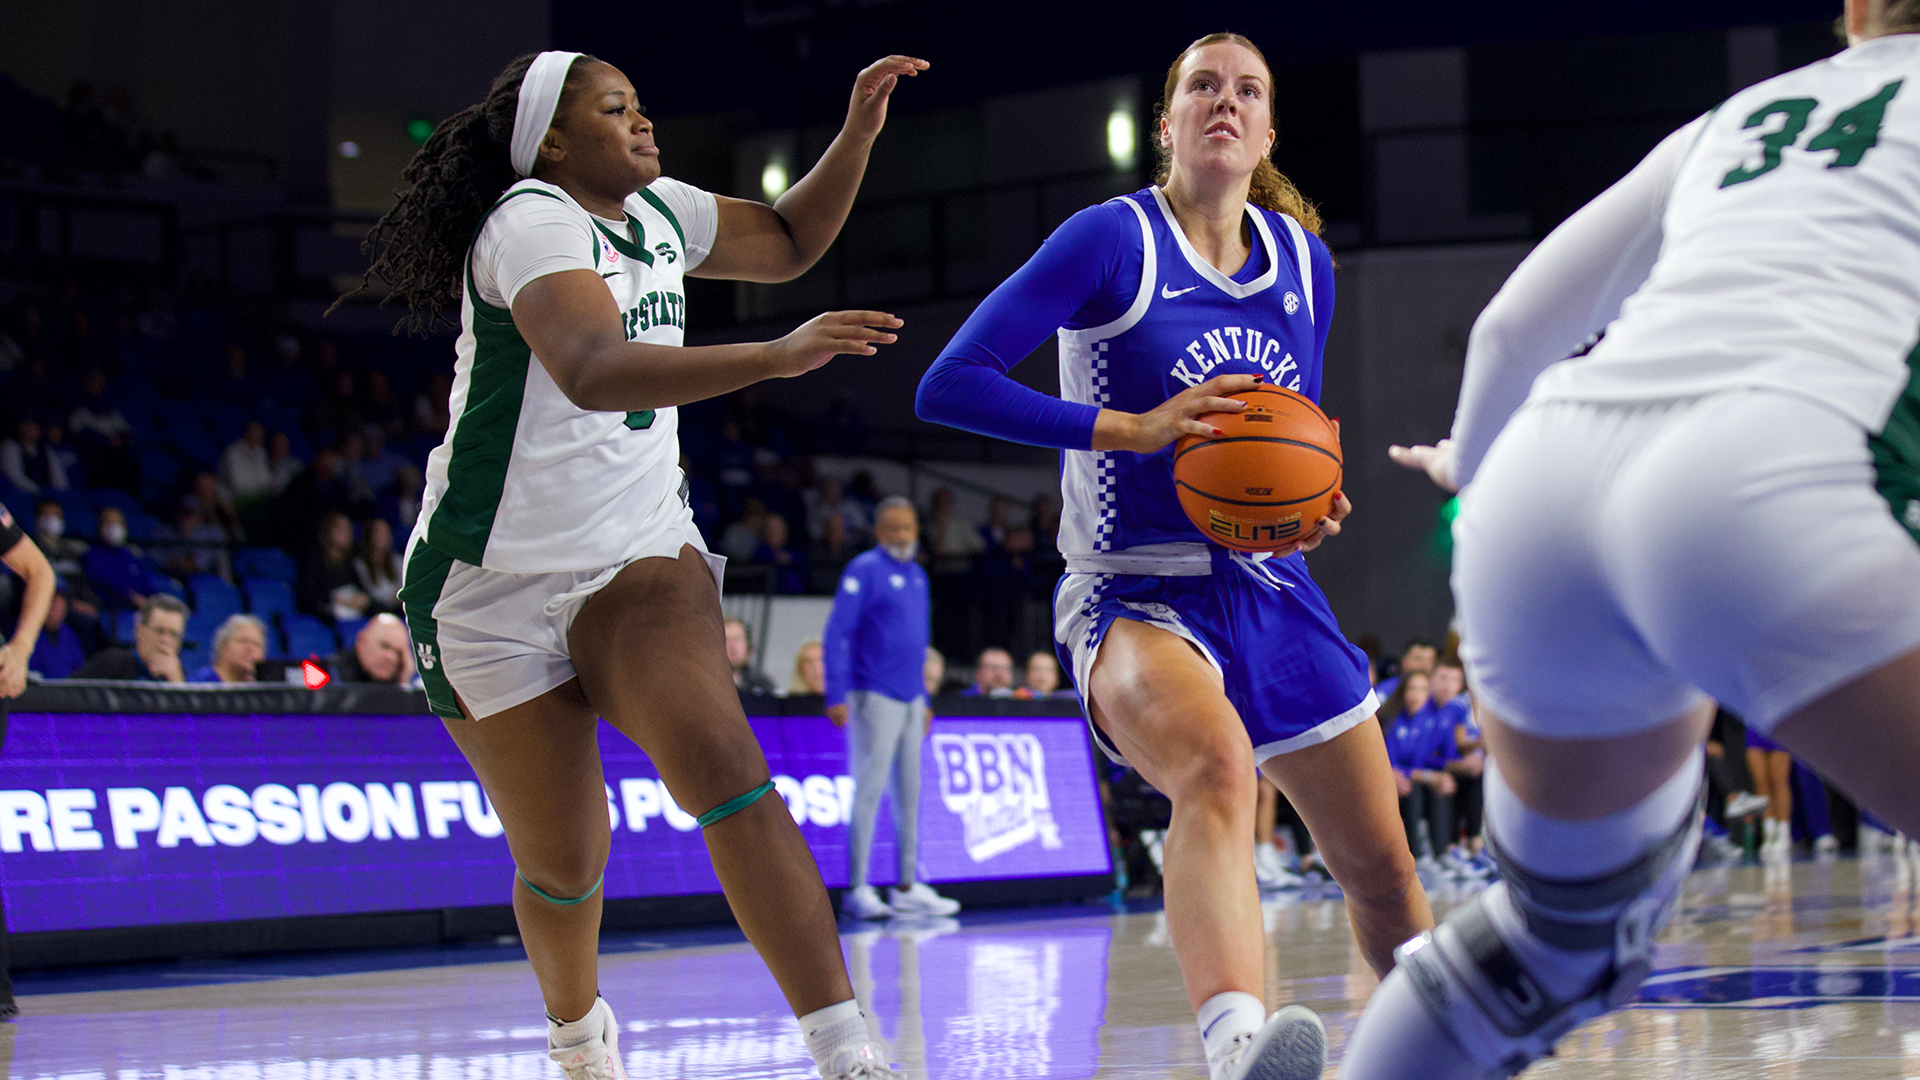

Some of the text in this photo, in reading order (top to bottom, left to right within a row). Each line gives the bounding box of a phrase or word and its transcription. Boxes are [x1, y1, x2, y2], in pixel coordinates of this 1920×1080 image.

[1717, 78, 1905, 190] 34
[933, 736, 1046, 806] BBN
[106, 782, 420, 850] PASSION
